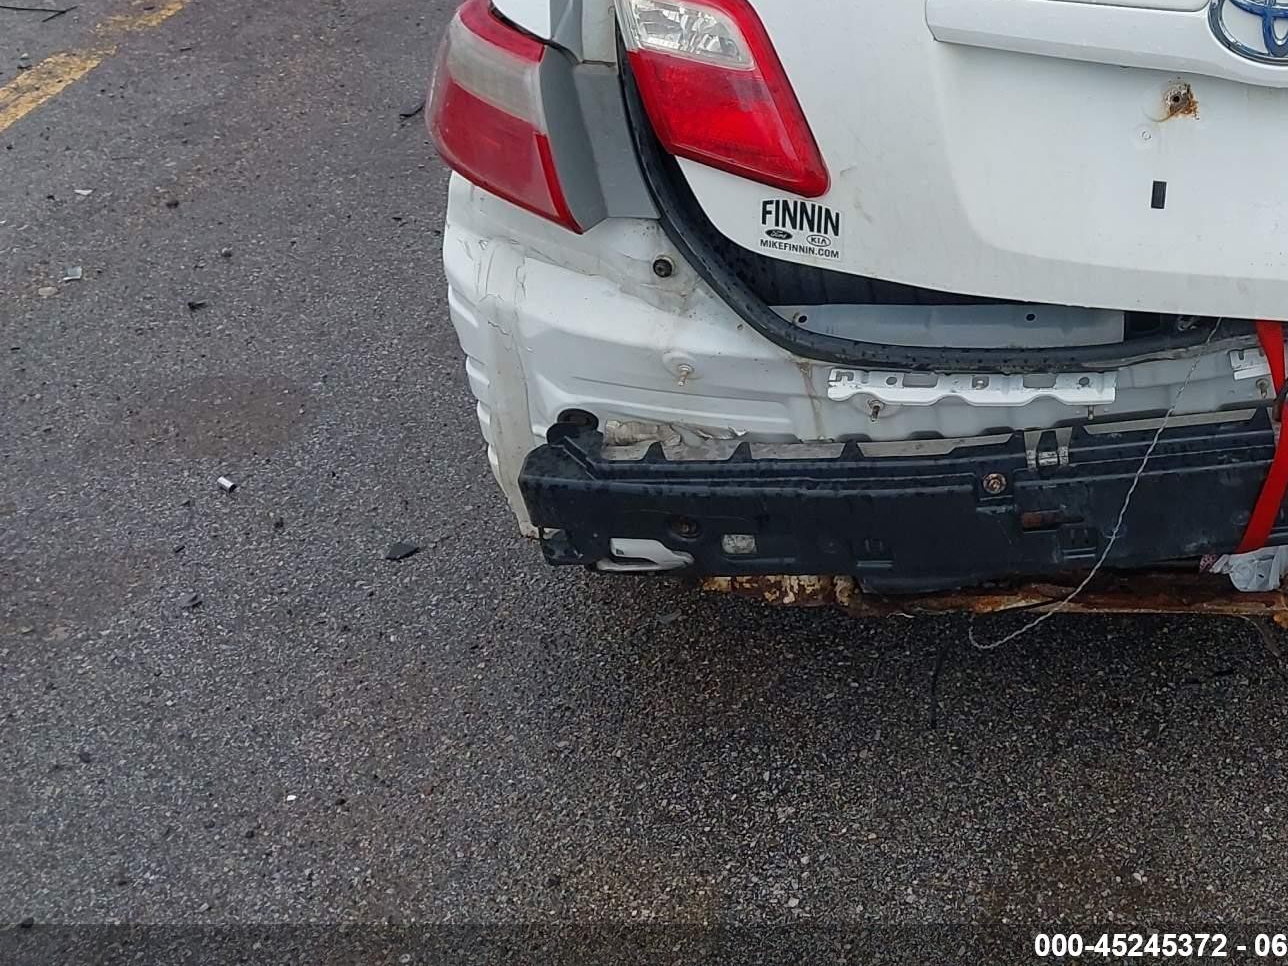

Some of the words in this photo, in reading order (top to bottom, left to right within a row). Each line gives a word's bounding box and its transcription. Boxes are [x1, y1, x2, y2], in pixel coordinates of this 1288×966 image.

[761, 199, 841, 237] FINNIN
[760, 239, 840, 259] MIKEFINNIN.COM
[810, 237, 828, 245] KIA
